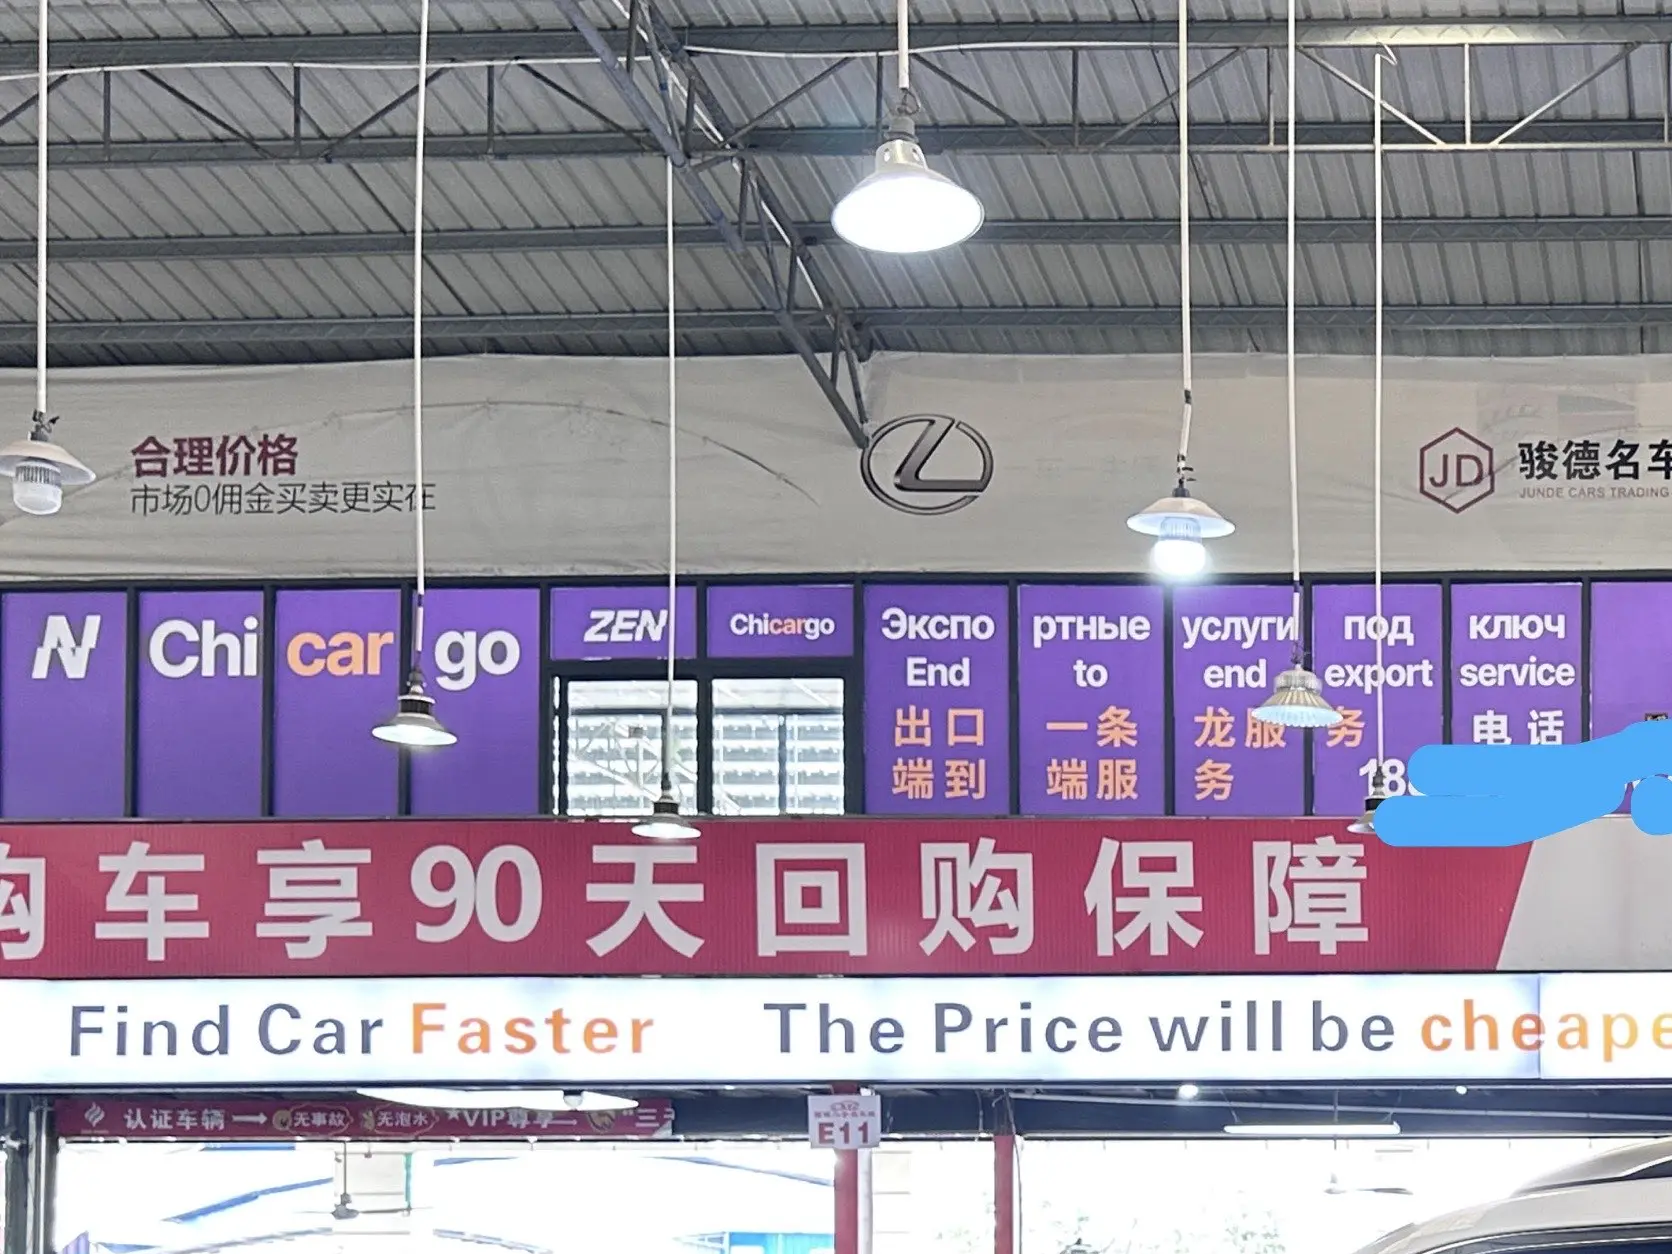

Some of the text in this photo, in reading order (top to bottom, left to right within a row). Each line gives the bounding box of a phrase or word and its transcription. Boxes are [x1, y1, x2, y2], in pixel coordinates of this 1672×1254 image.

[131, 434, 299, 477] 合理价格
[1429, 453, 1485, 488] JD
[130, 481, 436, 516] 市场0佣金买卖更实在
[1519, 486, 1564, 499] JUNDE
[1568, 486, 1605, 498] CARS
[1611, 486, 1670, 498] TRADING
[584, 609, 667, 644] ZEN
[730, 612, 837, 642] Chicargo
[881, 608, 1567, 649] Экспо ртные услуги под ключ
[149, 620, 522, 691] Chi car go
[905, 656, 1576, 694] End to end export service
[893, 706, 985, 748] 出口
[1047, 706, 1138, 747] 一条
[1326, 706, 1365, 748] 务
[1473, 710, 1565, 746] 电话
[892, 759, 1234, 800] 端到 端服 务
[70, 1004, 229, 1057] Find
[258, 1003, 384, 1055] Car
[412, 1002, 655, 1055] Faster
[763, 1003, 905, 1054] The
[935, 1001, 1123, 1054] Price
[1148, 1000, 1283, 1053] will
[1312, 1000, 1395, 1053] be
[124, 1107, 225, 1130] 认证车辆
[294, 1111, 345, 1127] 无事故
[818, 1121, 869, 1144] E11
